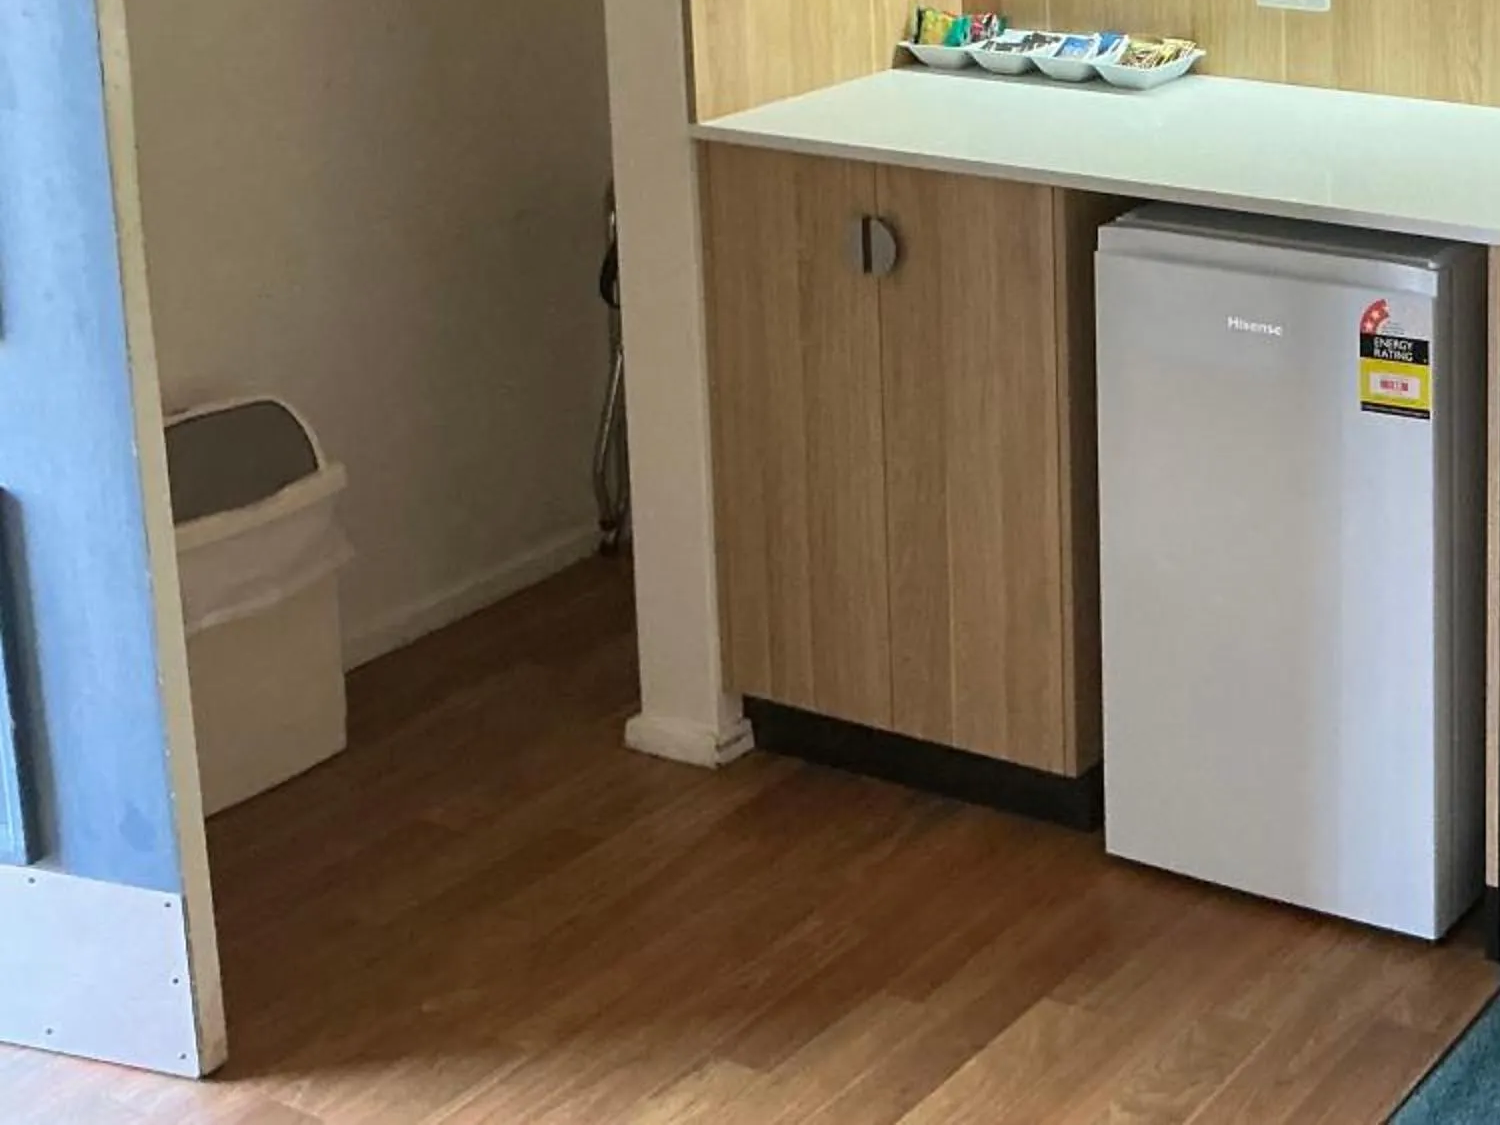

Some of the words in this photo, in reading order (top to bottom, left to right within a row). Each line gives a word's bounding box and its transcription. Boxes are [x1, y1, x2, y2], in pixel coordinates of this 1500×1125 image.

[1227, 316, 1282, 336] Hisense
[1373, 336, 1413, 351] ENERGY
[1373, 348, 1413, 362] RATING
